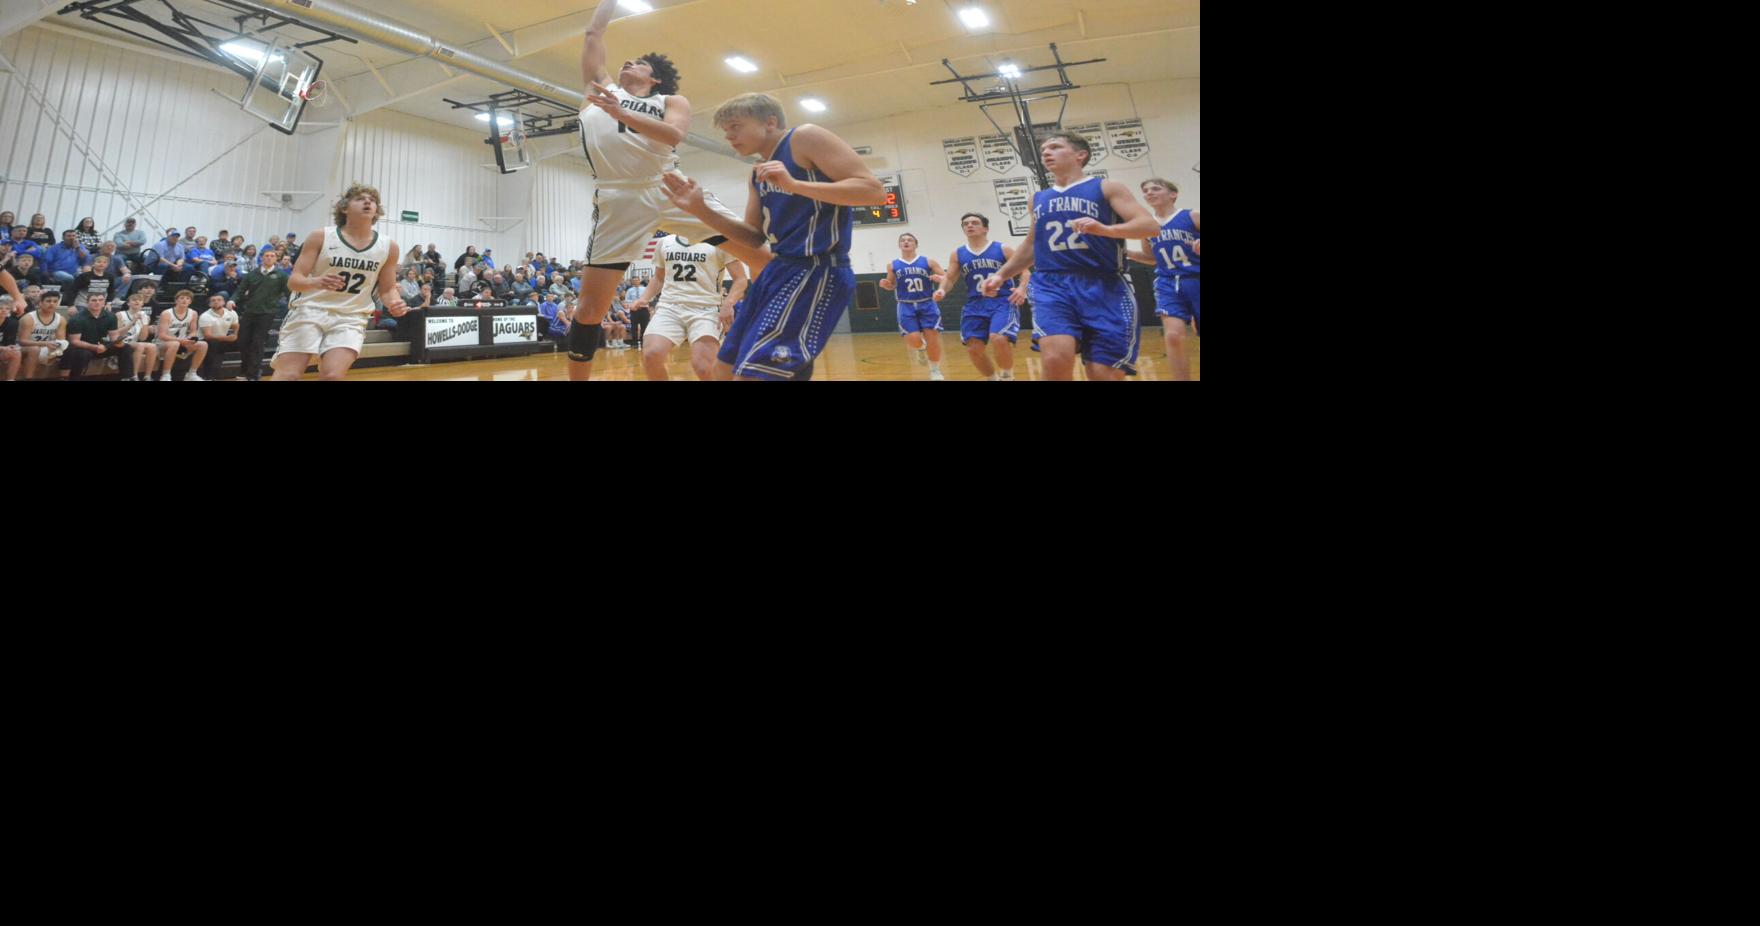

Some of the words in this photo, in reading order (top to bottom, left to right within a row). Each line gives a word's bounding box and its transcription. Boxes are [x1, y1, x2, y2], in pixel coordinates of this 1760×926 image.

[872, 210, 880, 218] 4
[890, 208, 899, 219] 3
[1048, 196, 1099, 218] FRANCIS
[1045, 219, 1089, 252] 22
[329, 256, 380, 272] JAGUARS
[665, 251, 706, 263] JAGUARS
[1159, 245, 1193, 269] 14
[672, 263, 697, 282] 22
[335, 270, 367, 295] 32
[905, 277, 924, 293] 20
[427, 319, 478, 346] HOWELLS-DODGE
[492, 321, 535, 338] JAGUARS
